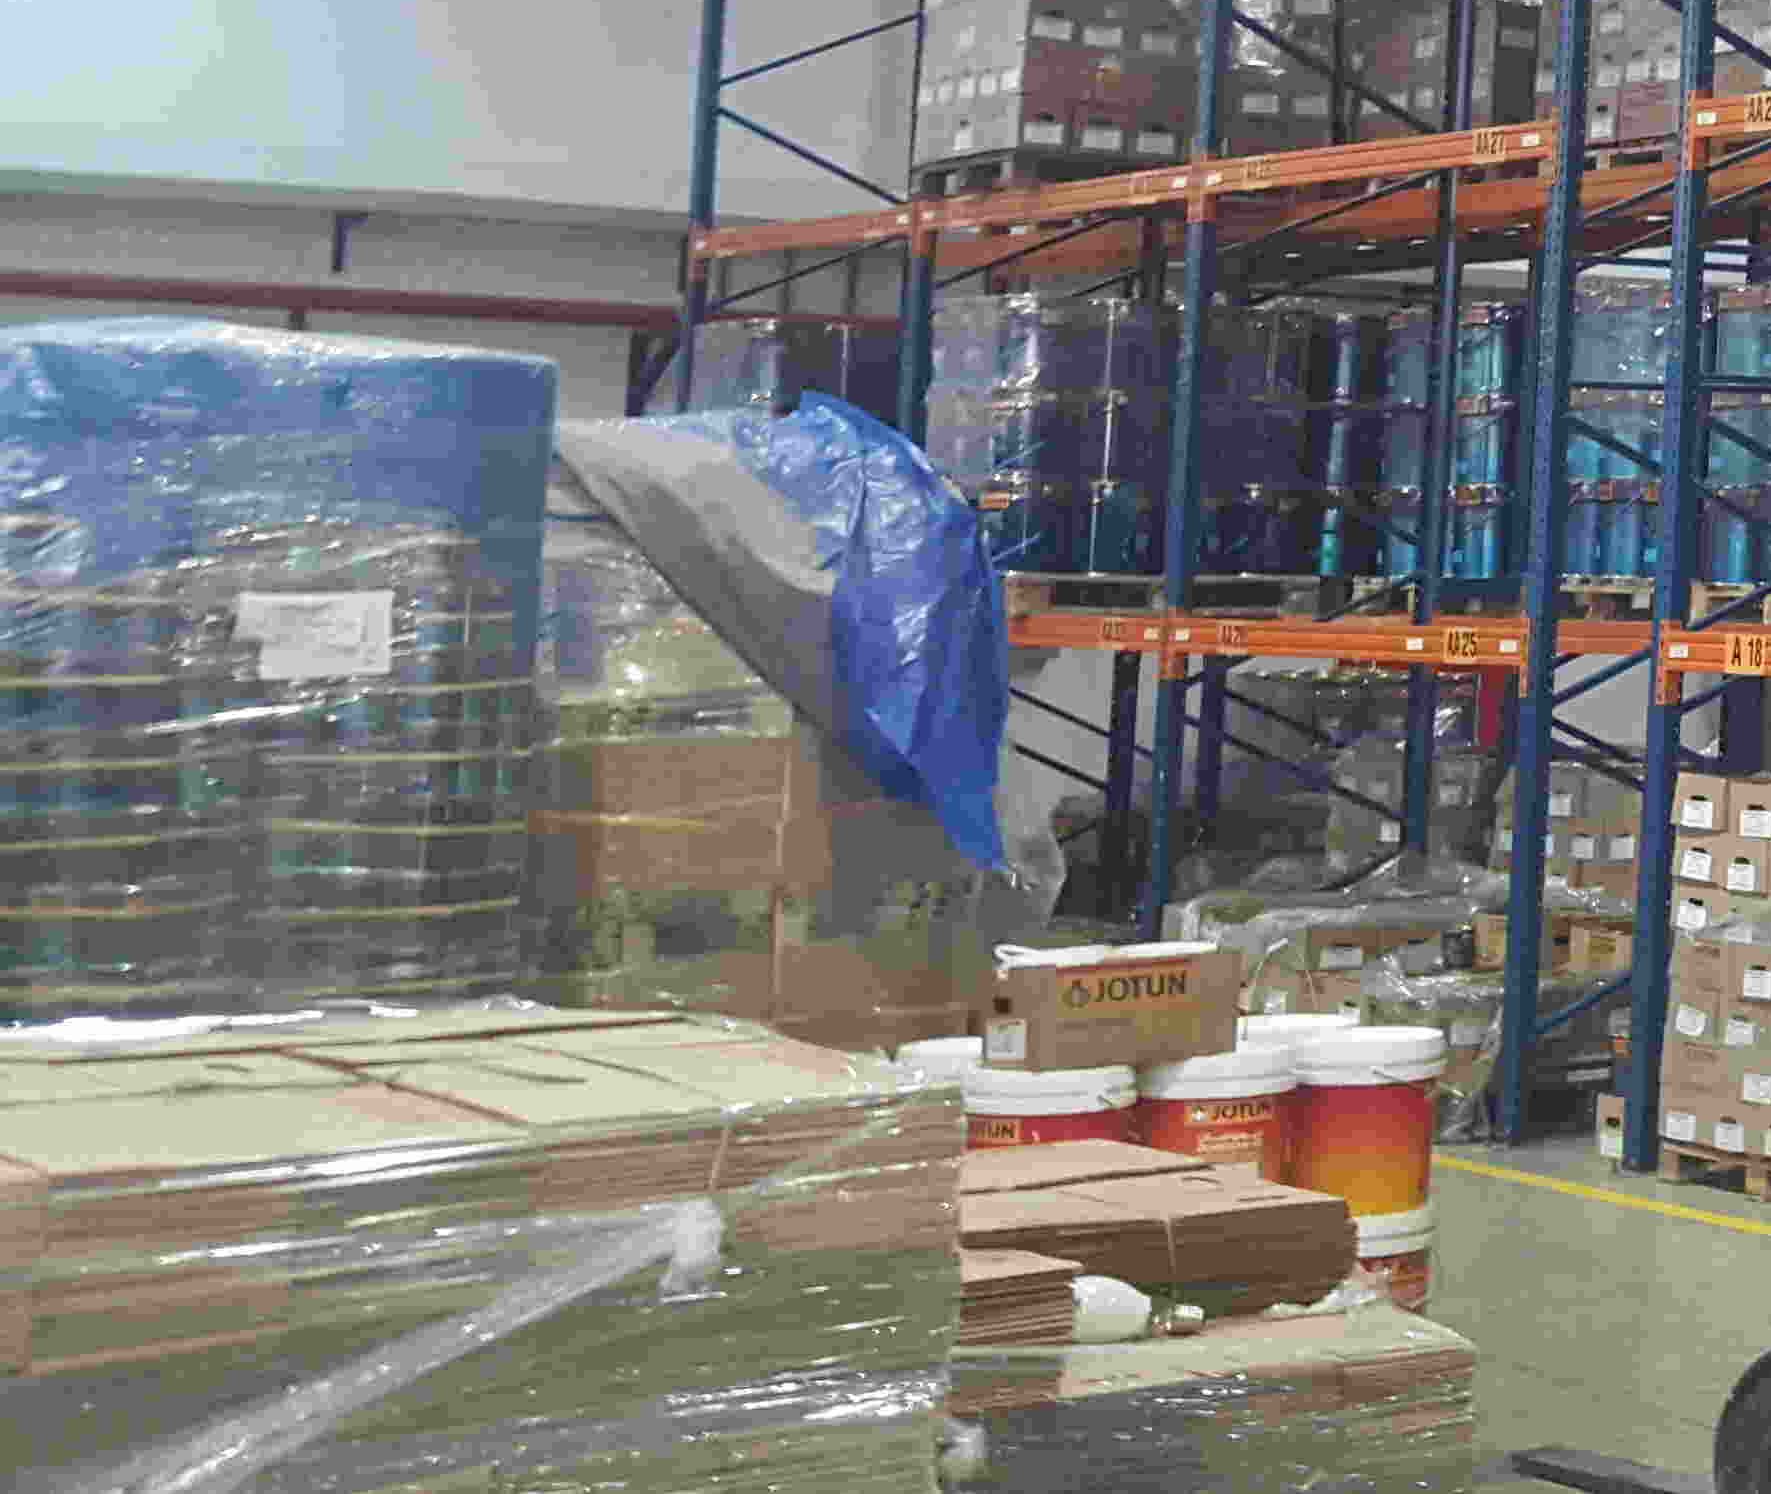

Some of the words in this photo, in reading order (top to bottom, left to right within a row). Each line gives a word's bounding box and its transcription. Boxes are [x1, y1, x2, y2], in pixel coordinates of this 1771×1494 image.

[1731, 640, 1743, 666] A
[1747, 641, 1764, 668] 18
[1093, 971, 1187, 1004] JOTUN
